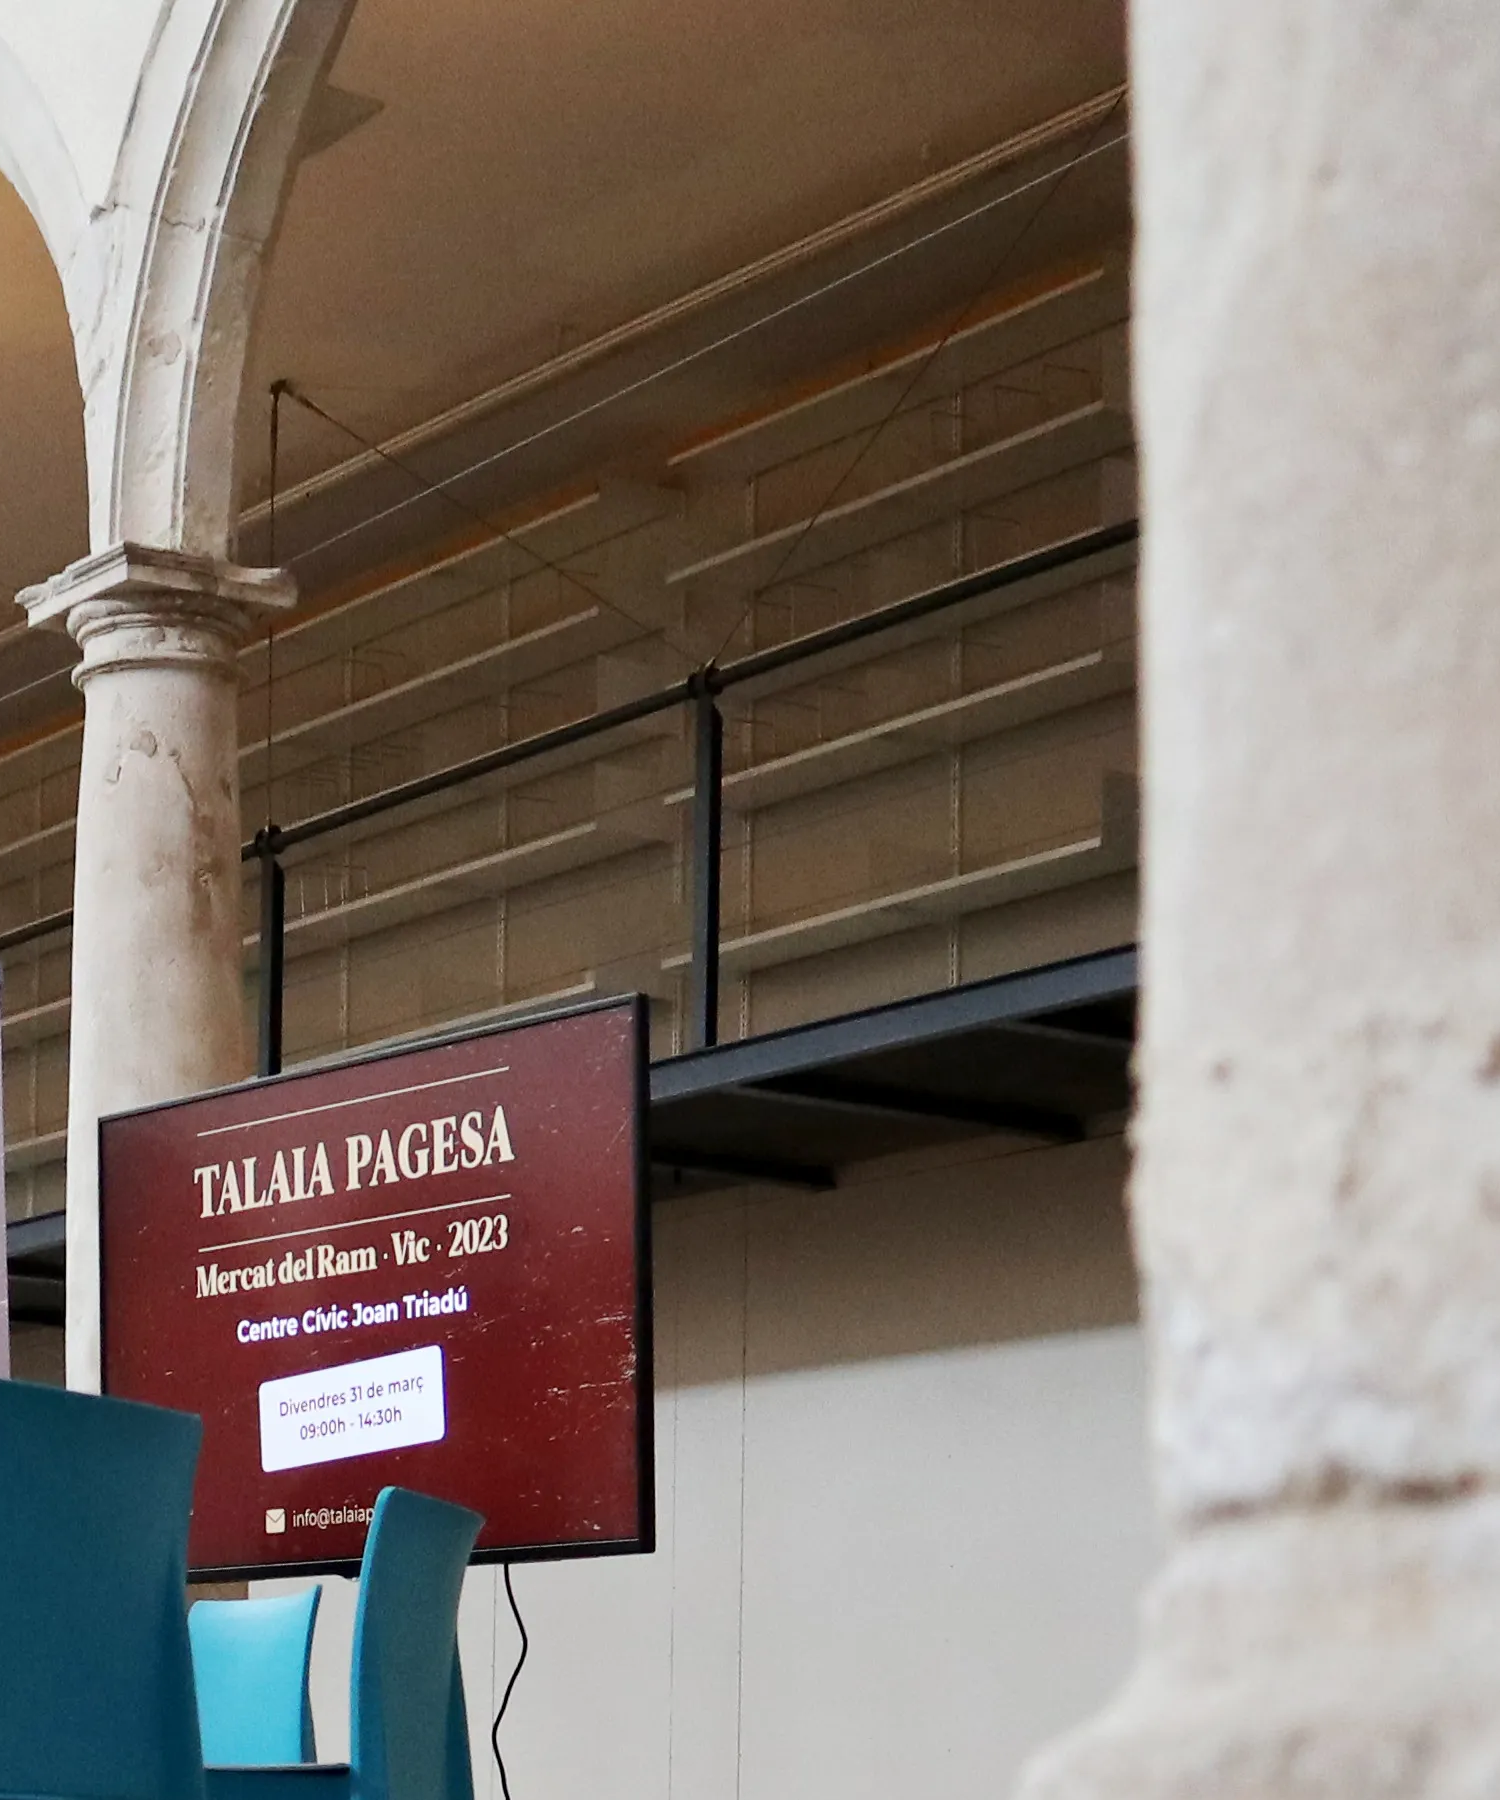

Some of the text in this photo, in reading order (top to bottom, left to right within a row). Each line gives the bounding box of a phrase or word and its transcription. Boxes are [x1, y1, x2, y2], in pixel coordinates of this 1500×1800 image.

[193, 1104, 515, 1219] TALAIA PAGESA
[195, 1258, 276, 1298] Mercat
[277, 1248, 315, 1286] del
[316, 1244, 378, 1280] Ram
[390, 1230, 431, 1266] Vic
[446, 1214, 509, 1258] 2023
[236, 1285, 468, 1343] Centre Cívic Joan Triadú
[279, 1375, 424, 1417] Divendres 31 de març
[299, 1417, 346, 1441] 09:00h
[358, 1406, 403, 1430] 14:30h
